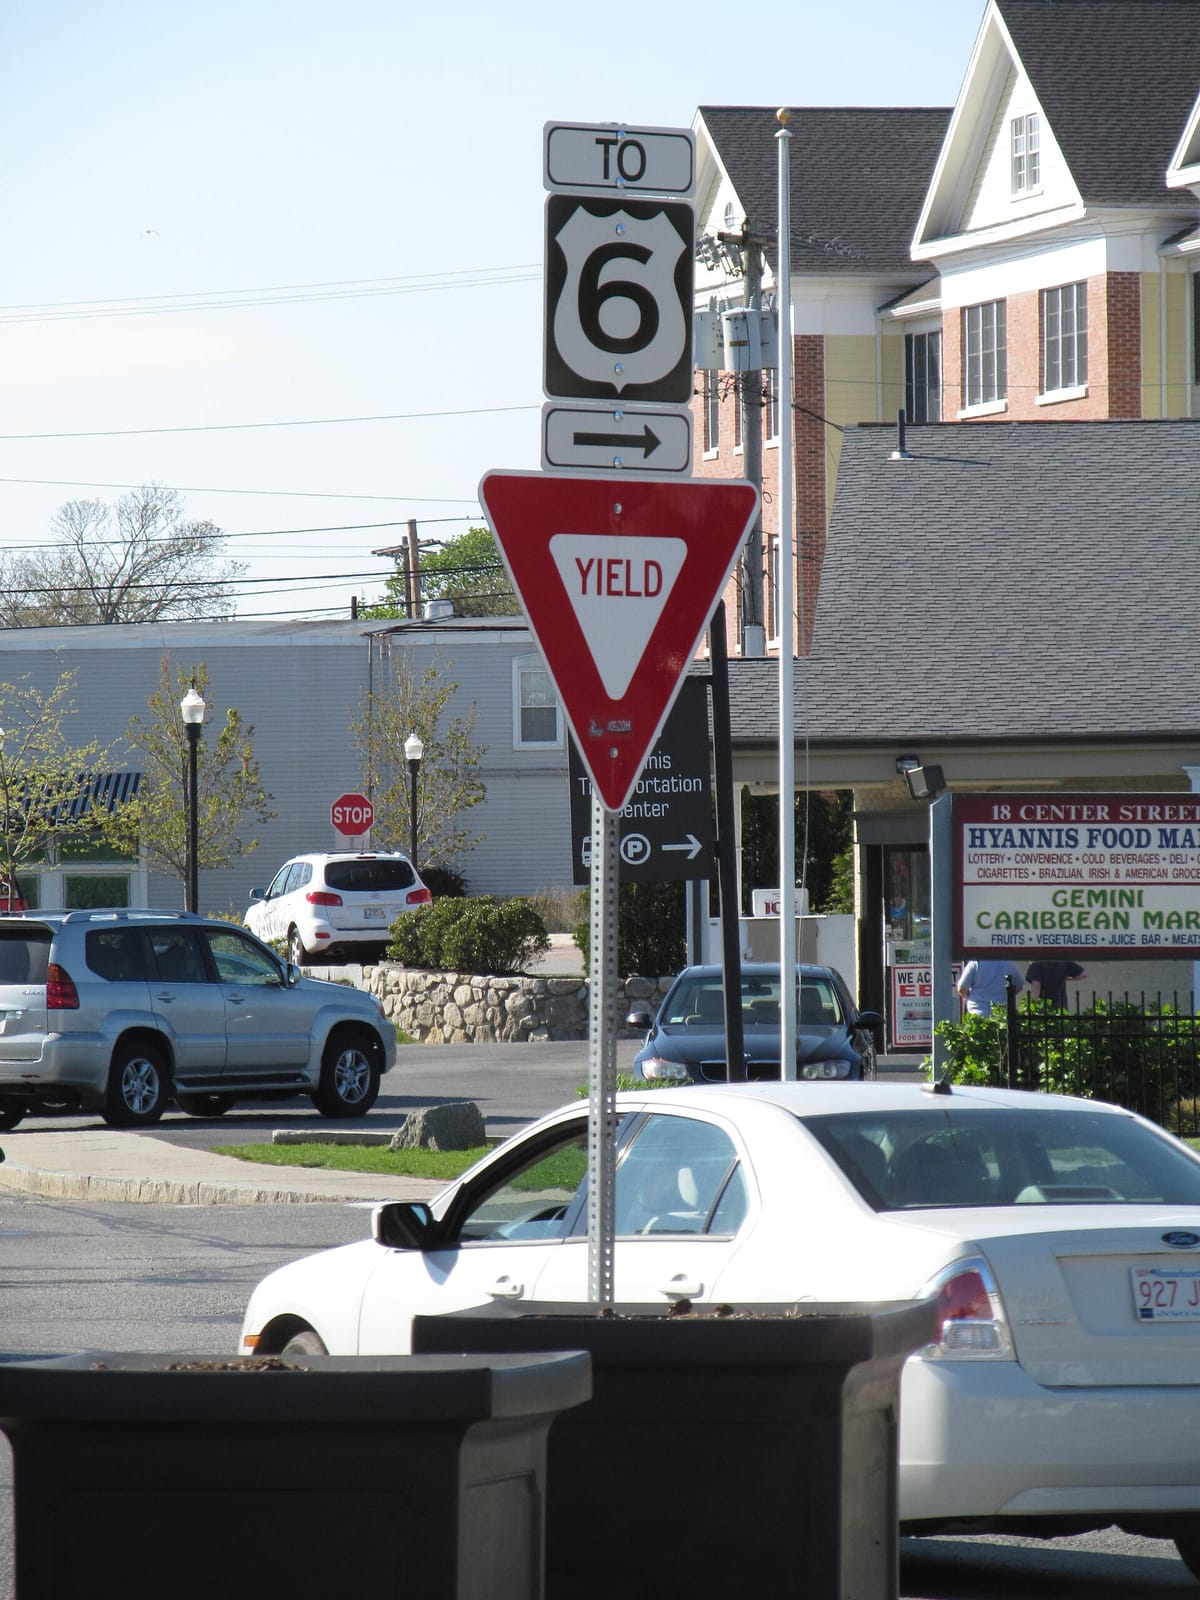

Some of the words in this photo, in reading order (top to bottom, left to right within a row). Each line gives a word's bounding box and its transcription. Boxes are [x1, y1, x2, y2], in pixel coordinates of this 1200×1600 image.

[595, 136, 647, 182] TO
[577, 241, 660, 354] 6
[574, 557, 663, 598] YIELD
[333, 807, 372, 823] STOP
[992, 804, 1012, 820] 18
[1020, 804, 1111, 821] CENTER
[968, 827, 1080, 849] HYANNIS
[1086, 827, 1152, 849] FOOD
[1157, 828, 1200, 849] MA
[968, 853, 1006, 865] LOTTERY
[1014, 853, 1074, 865] CONVENIENCE
[1082, 853, 1106, 865] COLD
[1110, 853, 1160, 865] BEVERAGES
[1169, 853, 1189, 865] DELI
[977, 867, 1030, 879] CIGARETTES
[1089, 867, 1111, 879] IRISH
[1114, 867, 1121, 879] &
[1125, 867, 1169, 879] AMERICAN
[1052, 889, 1144, 908] GEMINI
[976, 910, 1130, 930] CARIBBEAN
[991, 934, 1026, 945] FRUITS
[1036, 934, 1098, 945] VEGETABLES
[1108, 934, 1136, 945] JUICE
[1141, 934, 1161, 945] BAR
[897, 972, 914, 984] WE
[1140, 1280, 1178, 1307] 927
